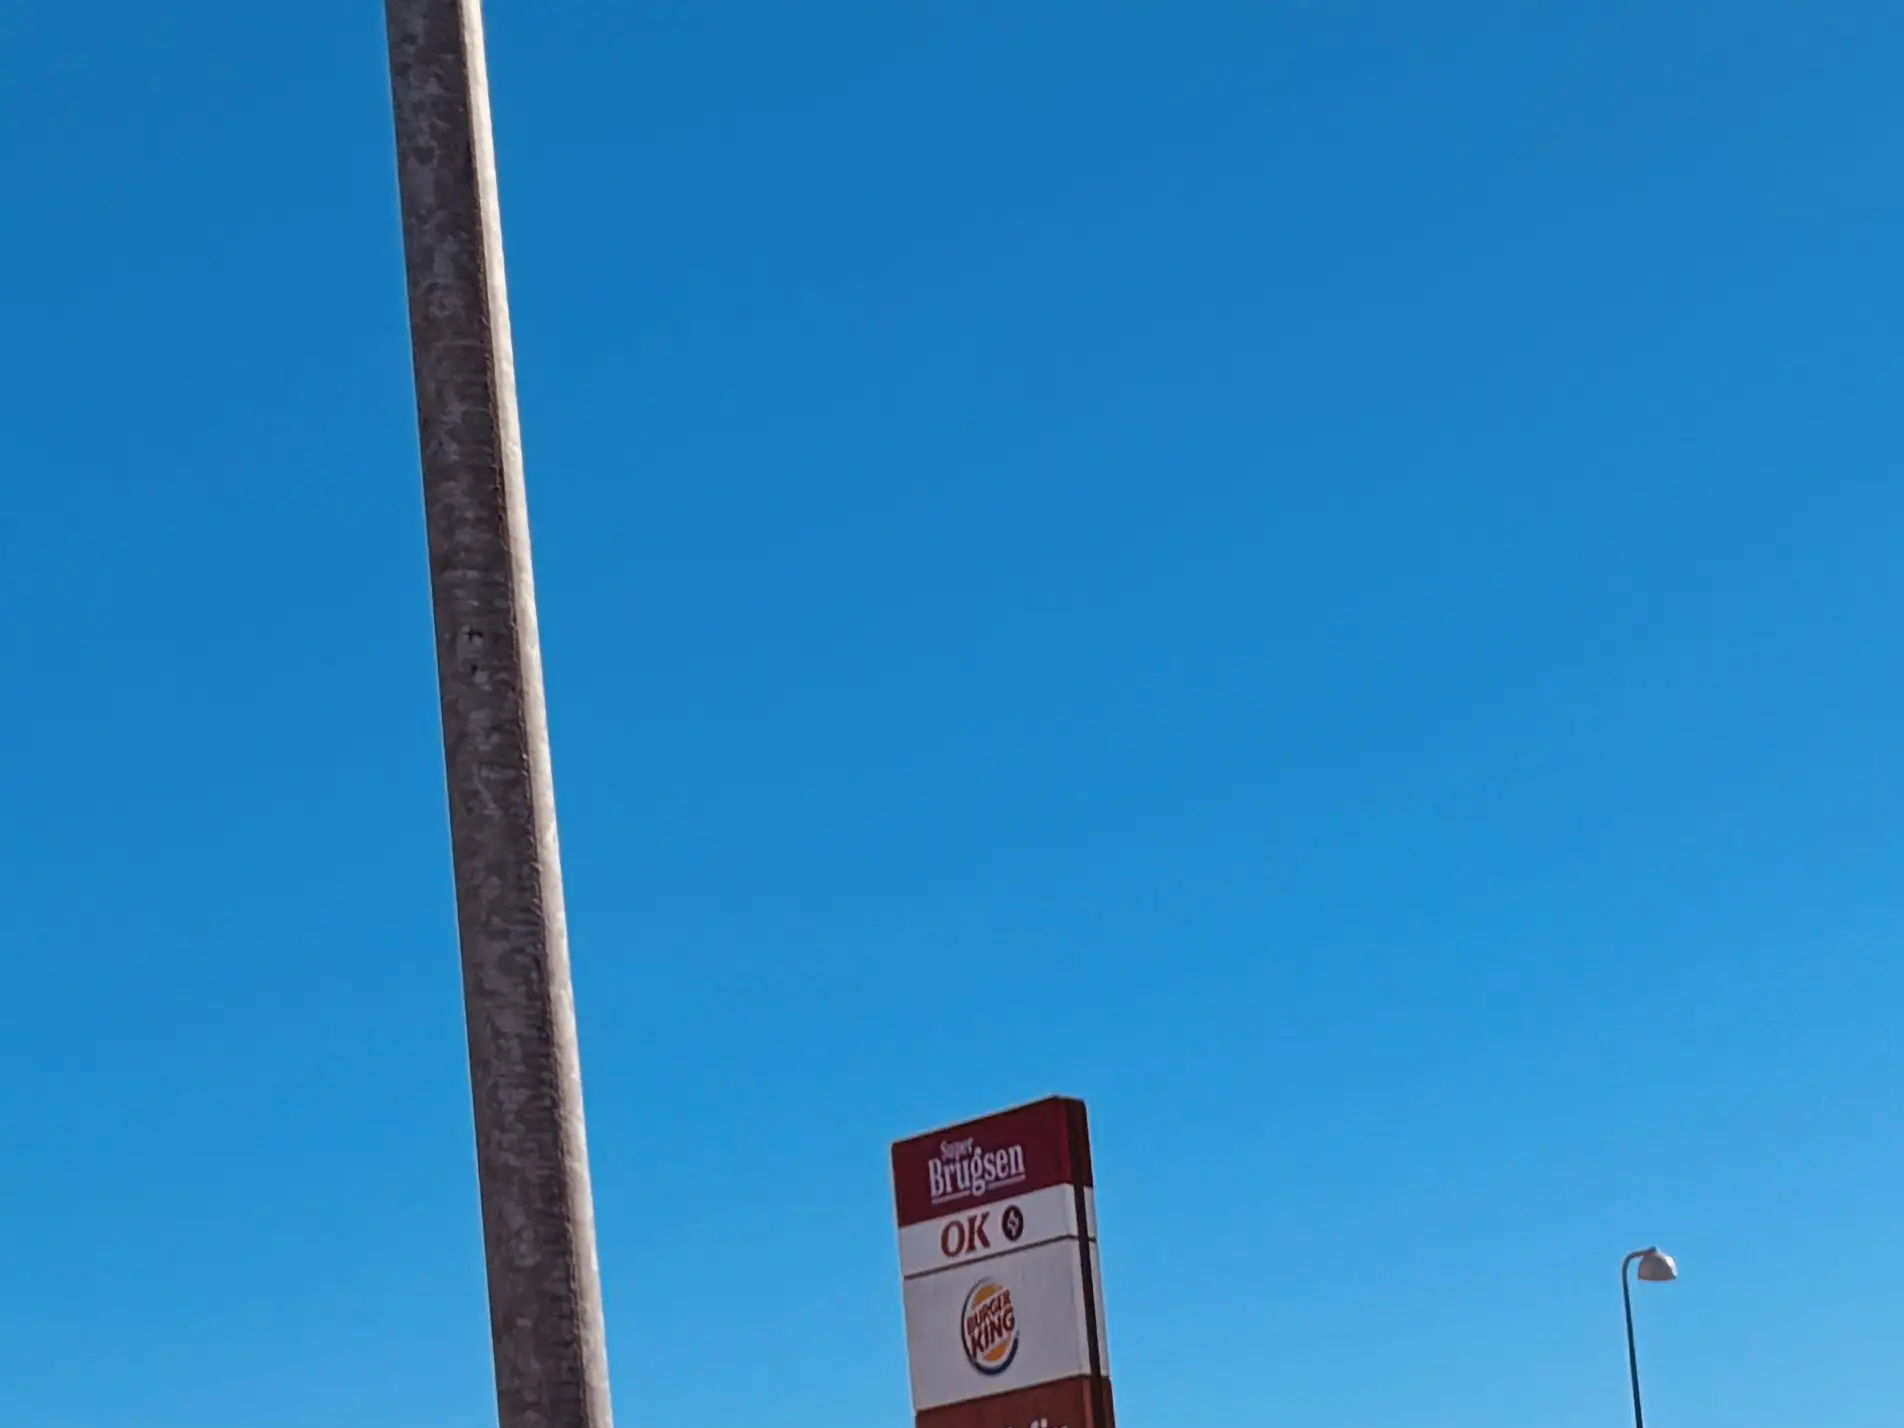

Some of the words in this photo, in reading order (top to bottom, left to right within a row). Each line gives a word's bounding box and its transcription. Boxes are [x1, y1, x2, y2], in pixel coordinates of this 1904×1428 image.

[928, 1144, 1025, 1197] Brugsen
[940, 1211, 990, 1257] OK
[971, 1306, 1015, 1358] KING
